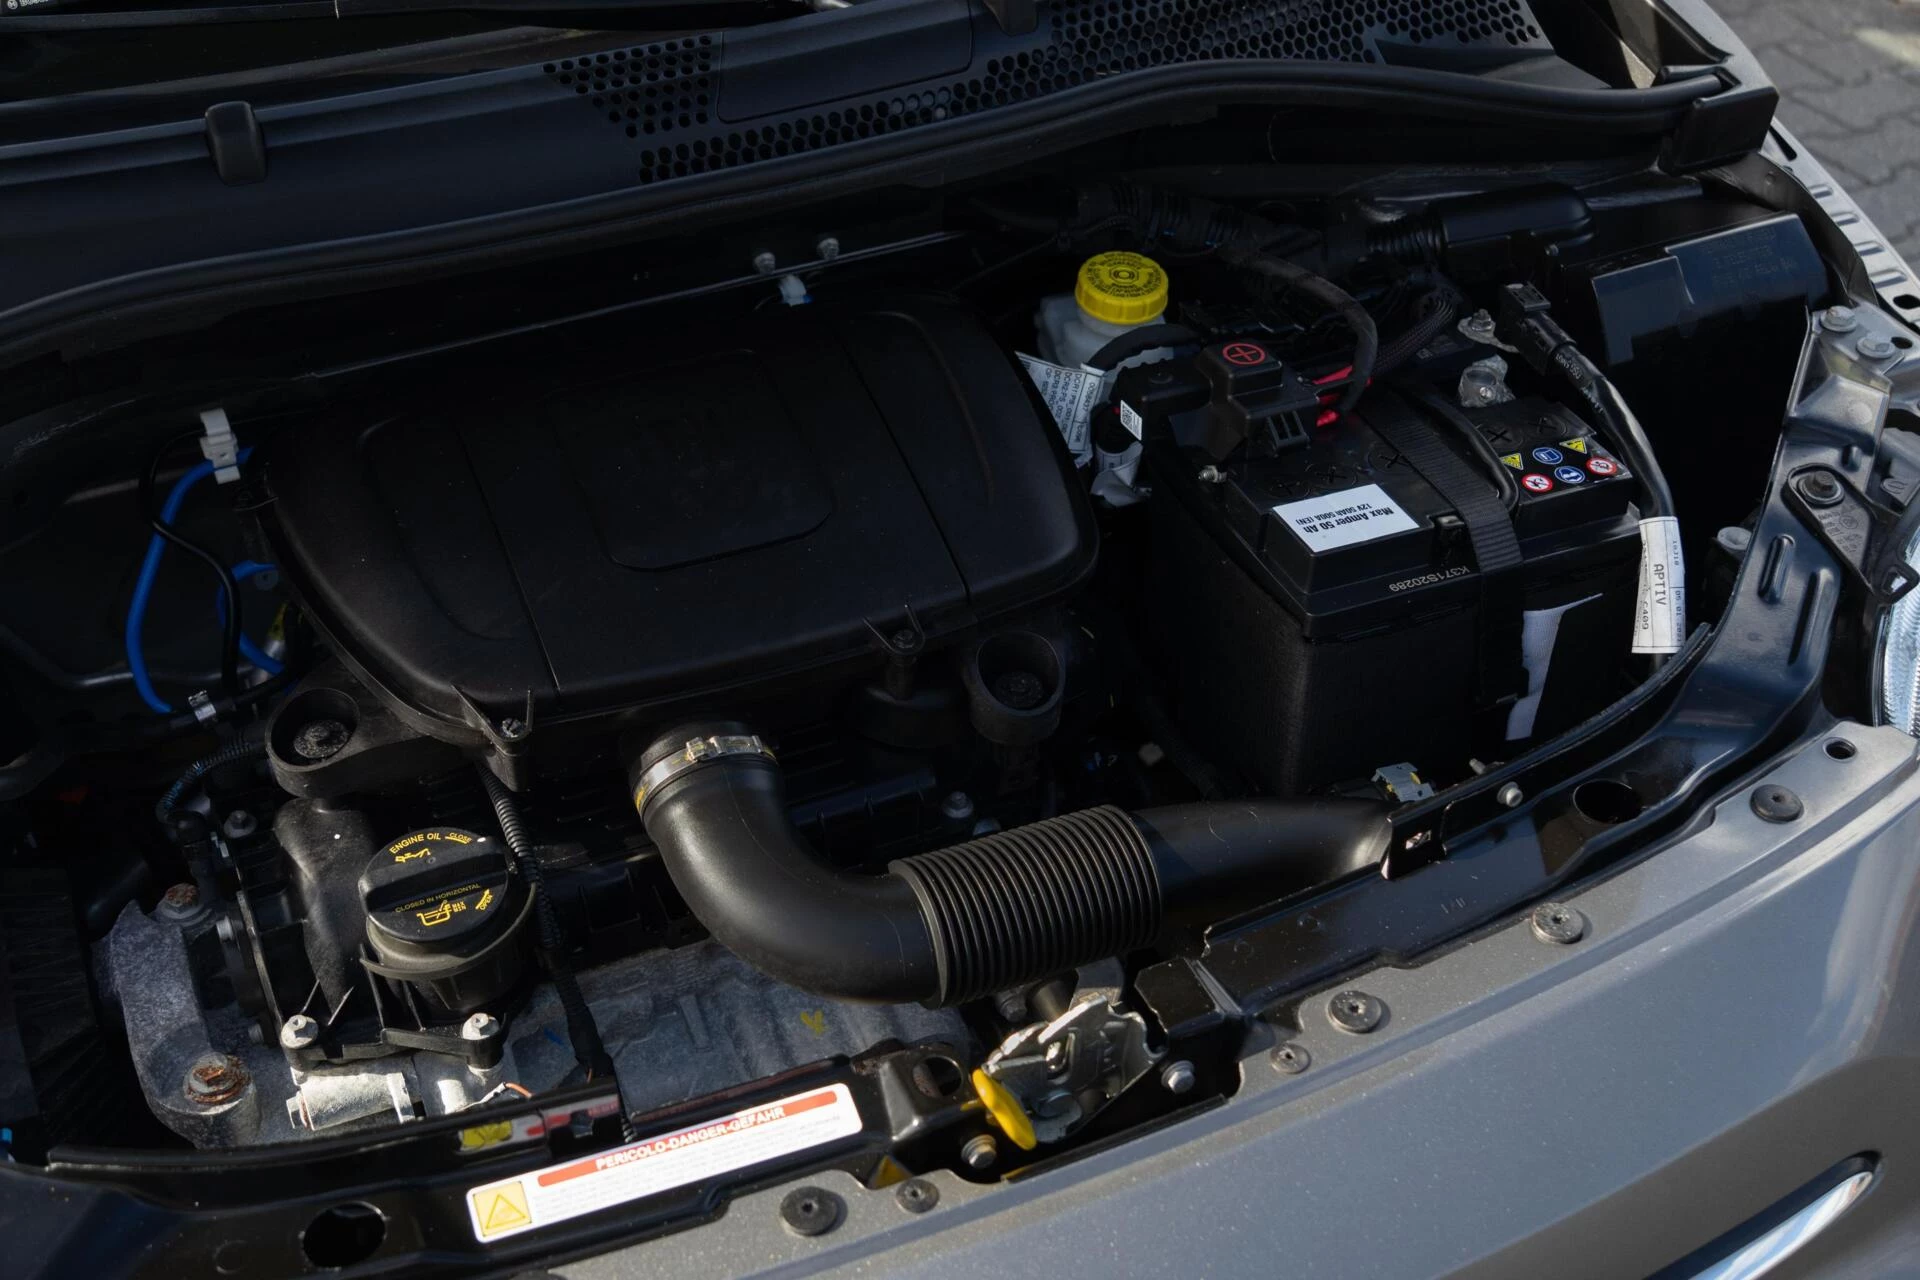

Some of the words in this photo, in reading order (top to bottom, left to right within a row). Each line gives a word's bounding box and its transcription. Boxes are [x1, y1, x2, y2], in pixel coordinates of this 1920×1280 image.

[1357, 503, 1372, 512] 12V
[1371, 507, 1394, 518] Max
[1296, 514, 1315, 526] (EN)
[1319, 519, 1335, 530] 50
[1336, 512, 1370, 528] Amper
[1303, 524, 1319, 533] Ah
[1388, 565, 1471, 592] K371S20289
[1653, 563, 1668, 606] APTIV
[389, 833, 425, 854] ENGINE
[427, 832, 442, 841] OIL
[449, 832, 473, 843] CLOSE
[394, 899, 425, 913] CLOSED
[435, 883, 481, 901] HORIZONTAL
[479, 894, 493, 911] OPEN
[595, 1106, 786, 1170] PERICOLO-DANGER-GEFAHR
